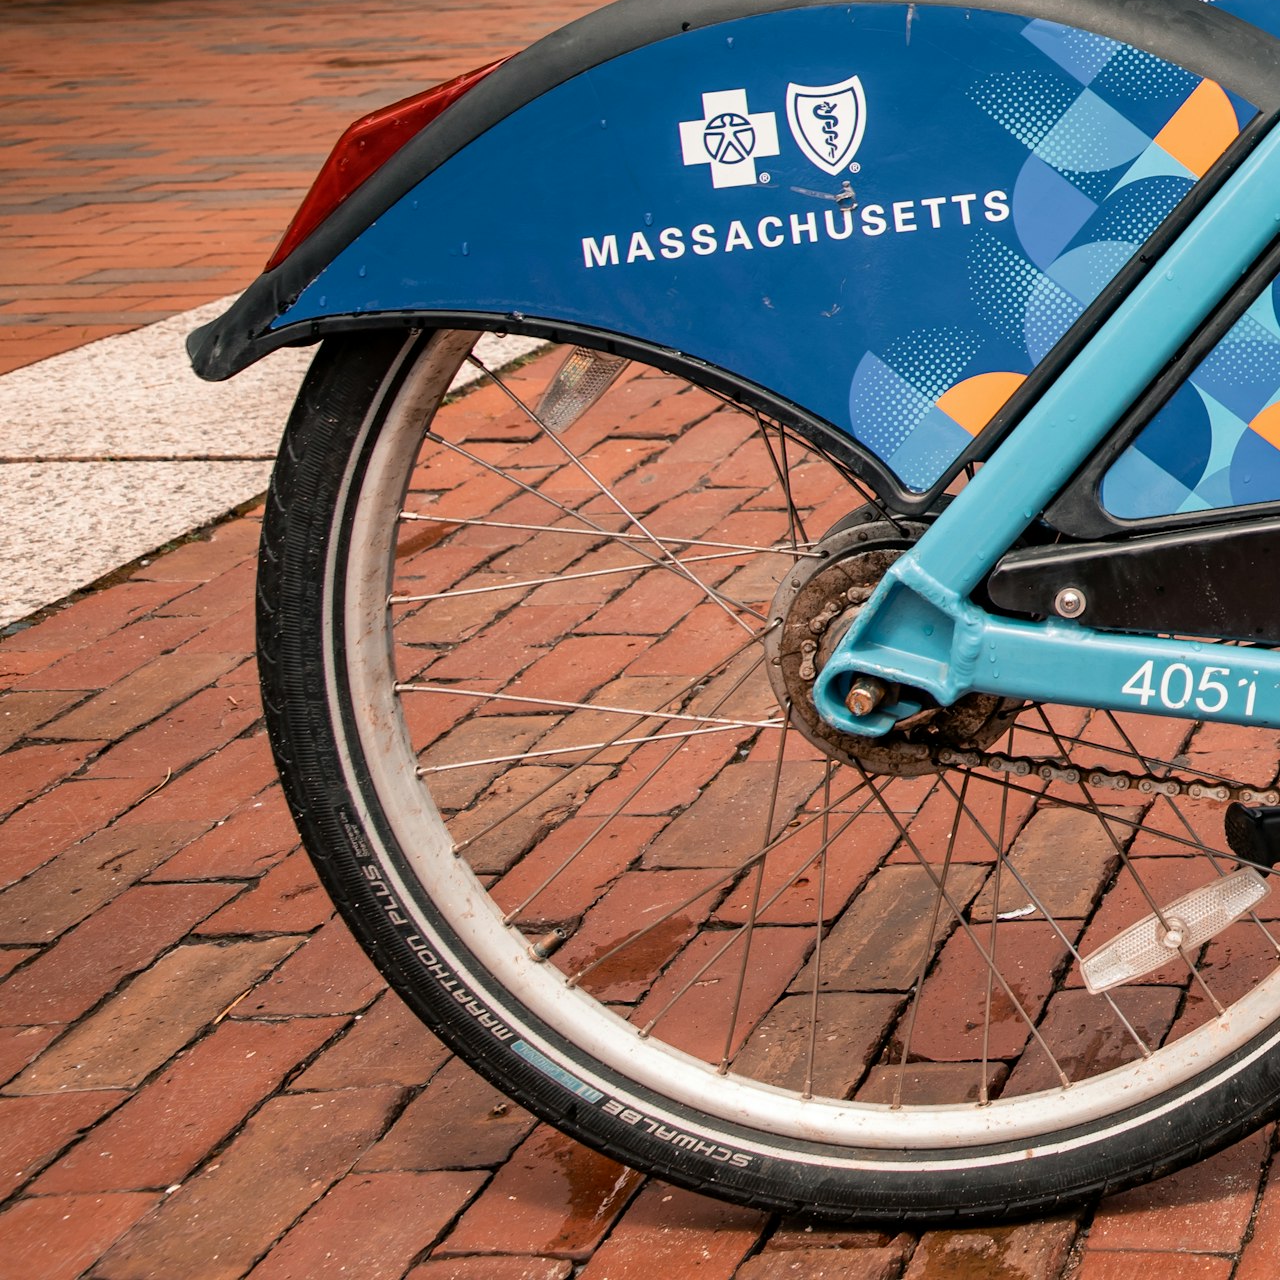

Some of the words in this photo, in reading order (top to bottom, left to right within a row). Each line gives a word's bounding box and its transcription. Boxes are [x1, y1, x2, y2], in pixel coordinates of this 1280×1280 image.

[581, 189, 1011, 269] MASSACHUSETTS
[362, 864, 409, 926] PLUS
[406, 934, 515, 1041] MARATHON
[602, 1099, 754, 1169] SCHWALBE
